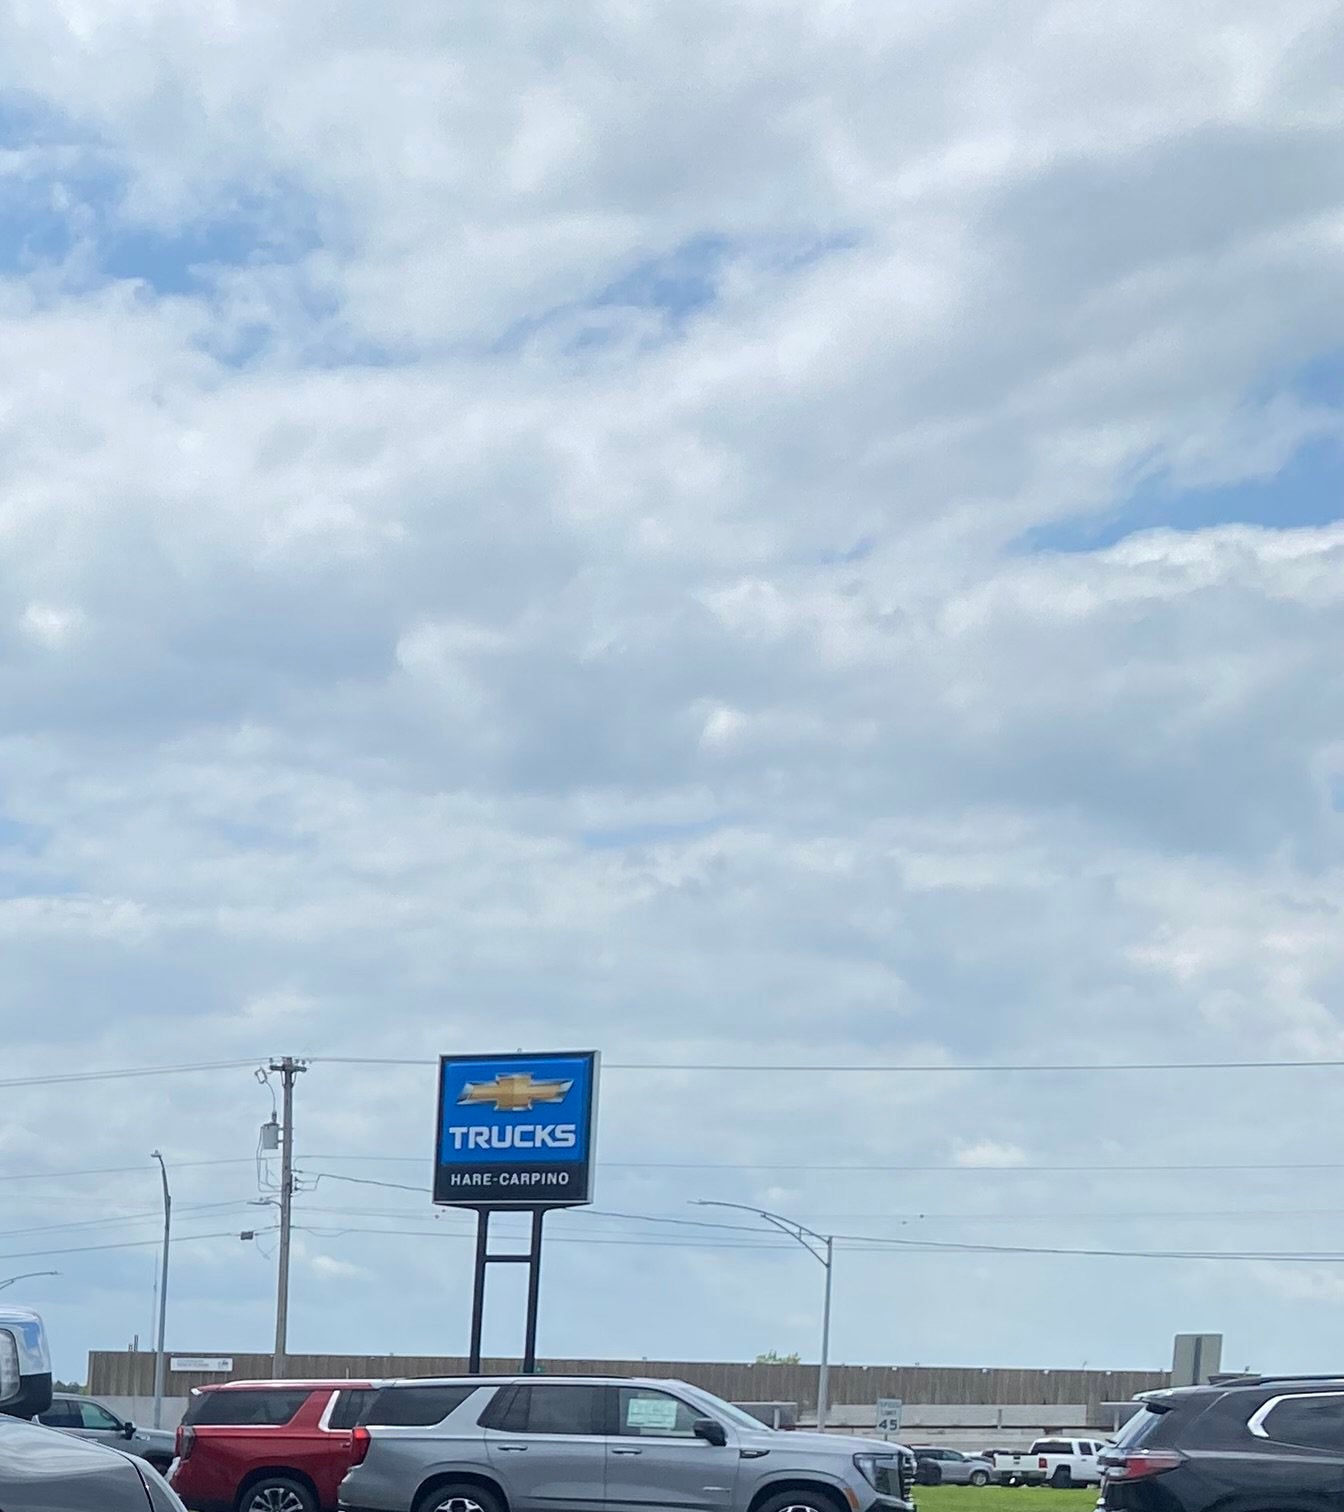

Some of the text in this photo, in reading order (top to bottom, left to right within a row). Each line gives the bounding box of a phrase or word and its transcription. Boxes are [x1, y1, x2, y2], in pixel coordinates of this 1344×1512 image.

[449, 1124, 576, 1149] TRUCKS
[450, 1172, 570, 1186] HARE-CARPINO
[878, 1419, 898, 1431] 45
